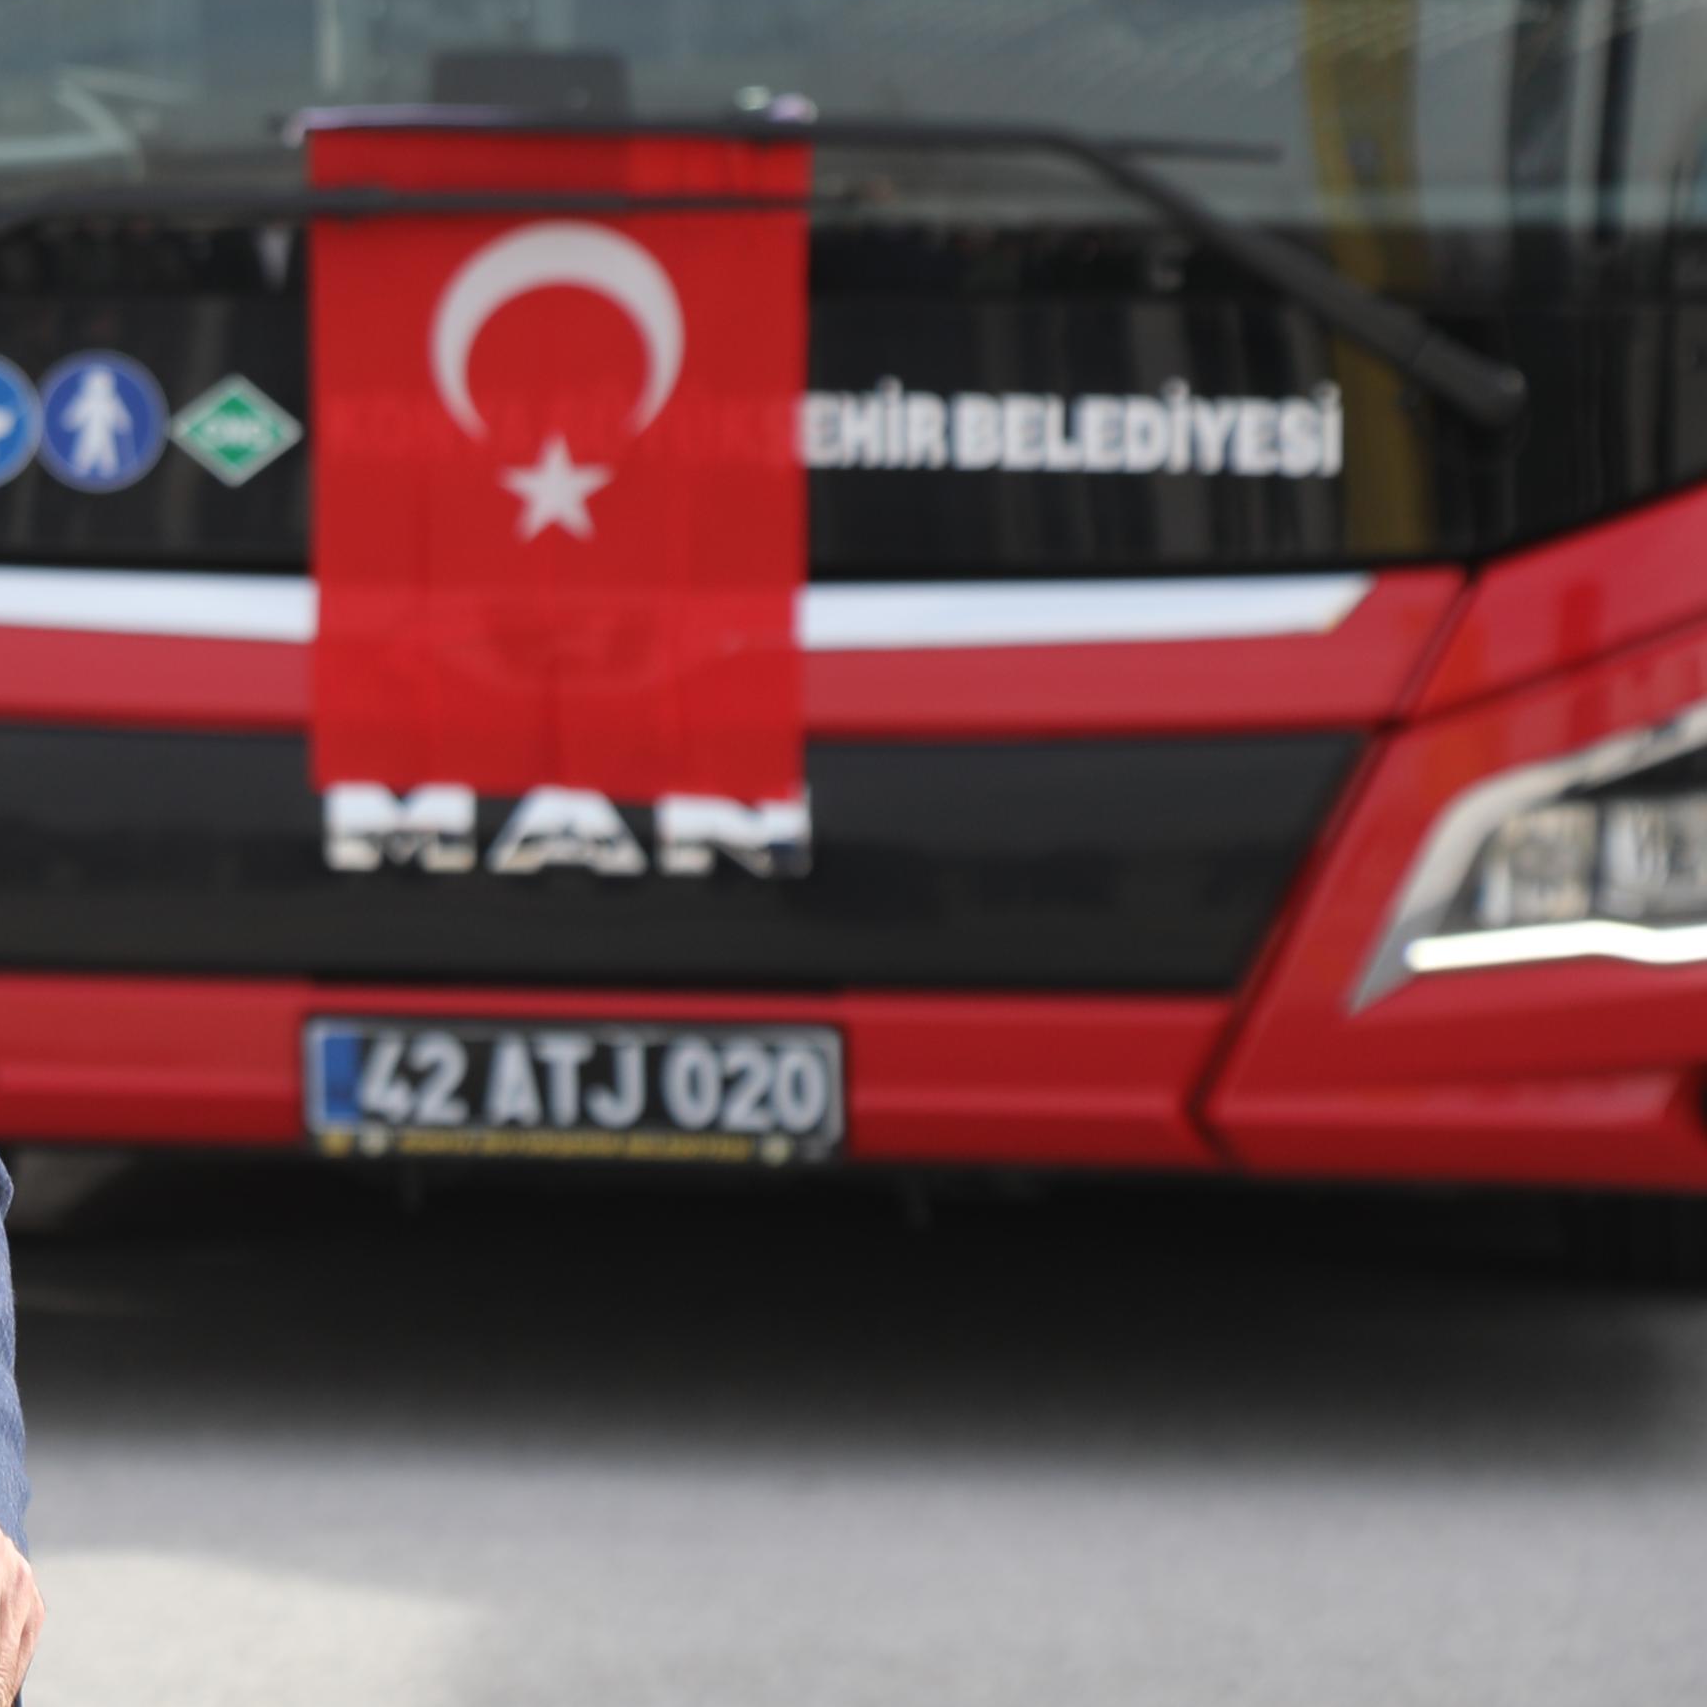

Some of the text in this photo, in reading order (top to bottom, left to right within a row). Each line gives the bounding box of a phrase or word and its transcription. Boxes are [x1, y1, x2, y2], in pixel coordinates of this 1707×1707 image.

[949, 376, 1343, 478] BELEDİYESİ
[325, 781, 813, 877] MAN
[359, 1029, 829, 1134] 42 ATJ 020
